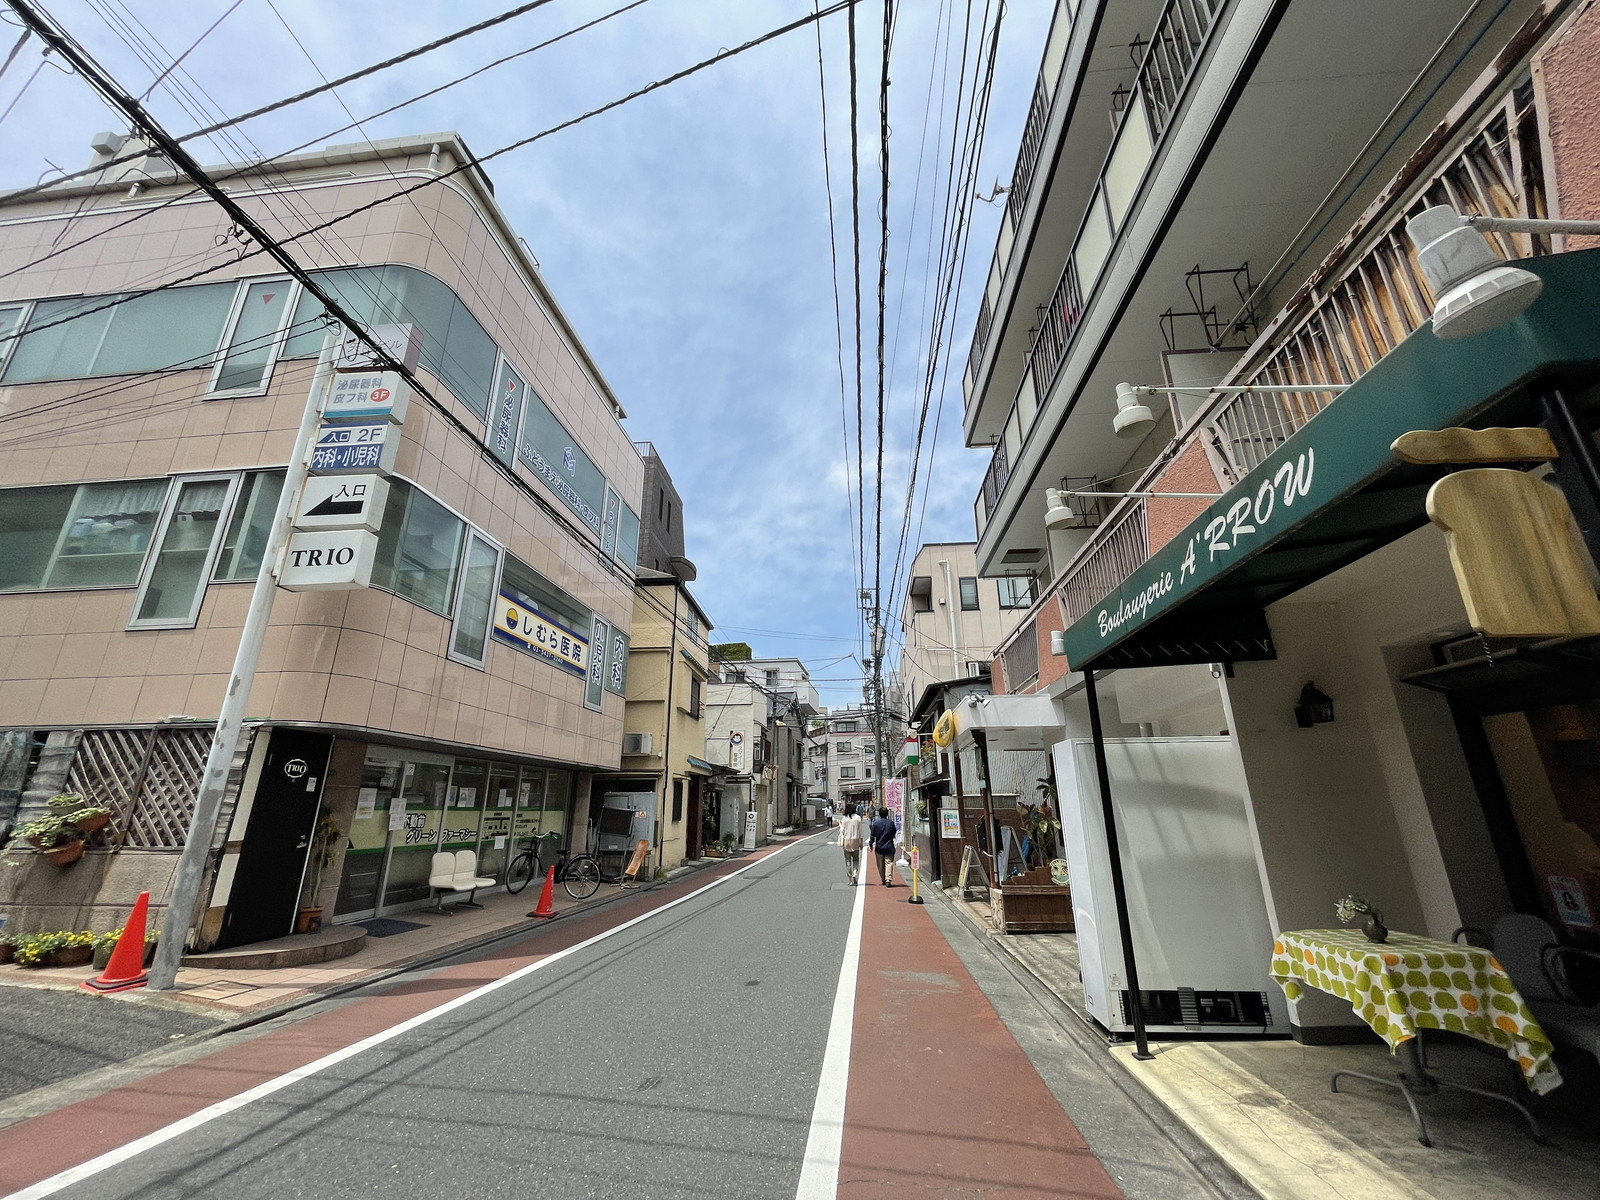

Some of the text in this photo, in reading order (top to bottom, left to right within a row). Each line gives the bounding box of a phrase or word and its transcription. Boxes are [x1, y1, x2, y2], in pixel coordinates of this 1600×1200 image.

[337, 377, 383, 391] 泌尿器科
[333, 391, 368, 404] 皮フ科
[371, 390, 389, 402] 3F
[328, 431, 350, 443] 入口
[358, 427, 383, 442] 2F
[311, 446, 380, 468] 内科・小児科
[335, 484, 367, 499] 入口
[1097, 446, 1315, 638] Boulangerie A'RROW
[291, 547, 354, 567] TRIO
[523, 615, 582, 663] しむら医院
[592, 622, 605, 685] 小児科
[612, 635, 625, 690] 内科
[286, 763, 308, 774] TRIO
